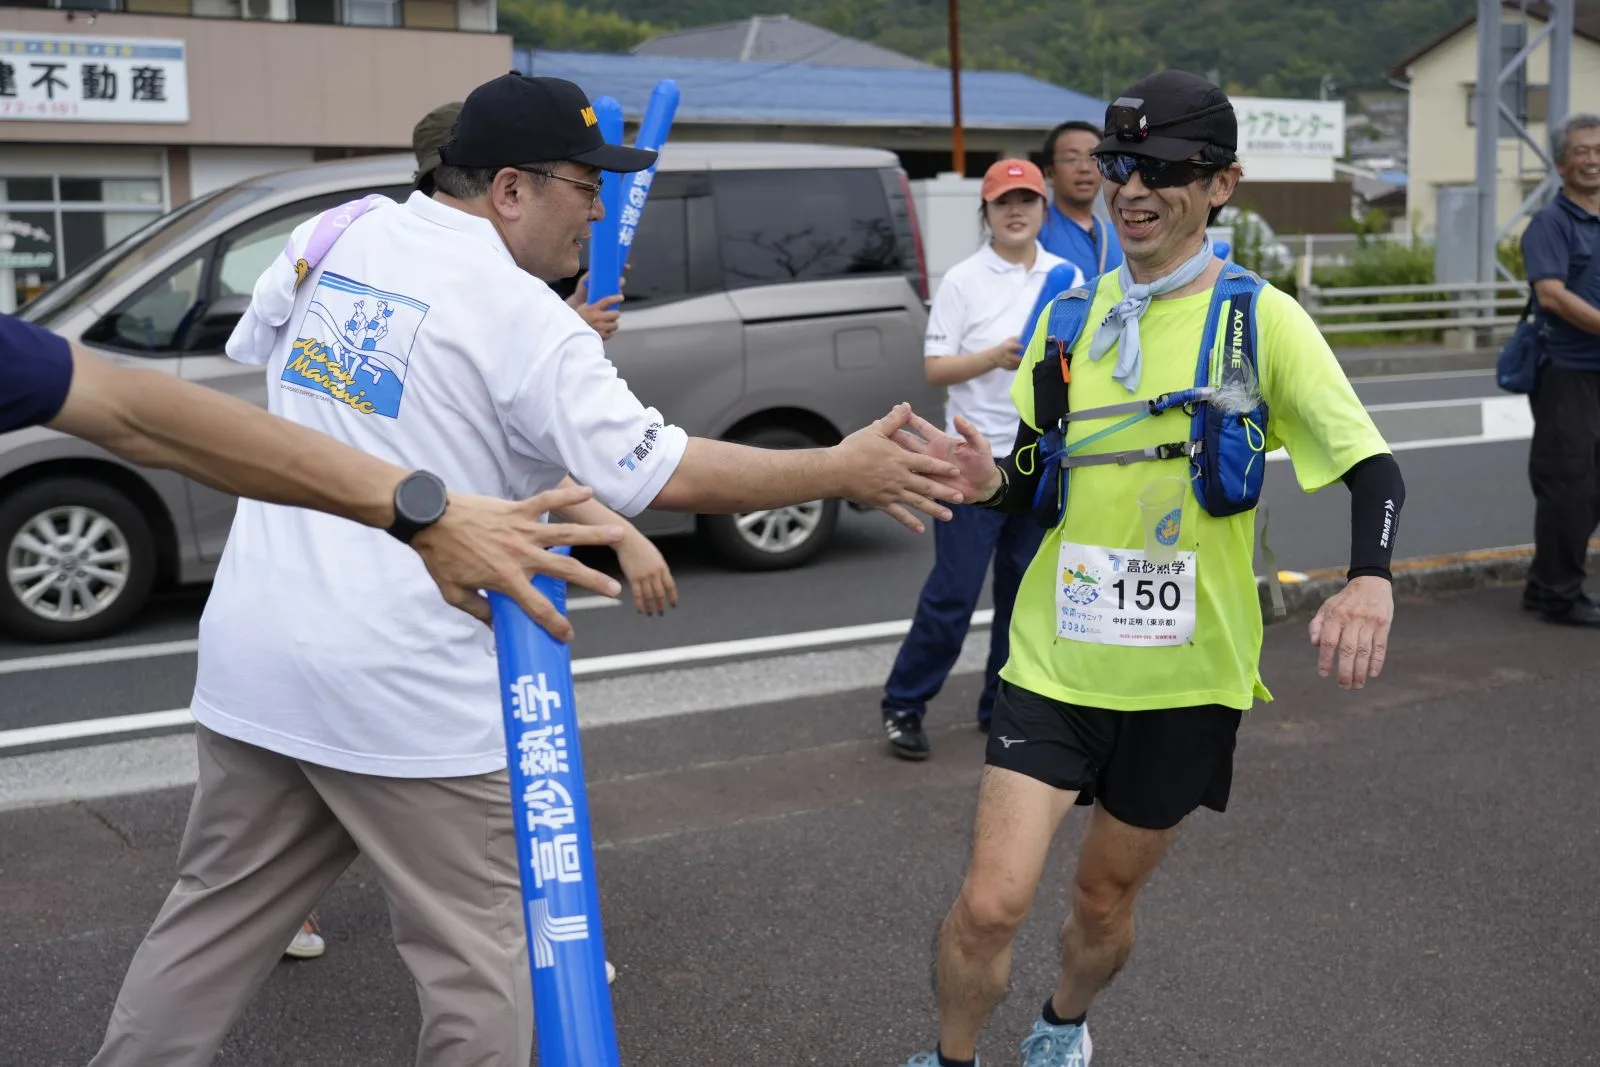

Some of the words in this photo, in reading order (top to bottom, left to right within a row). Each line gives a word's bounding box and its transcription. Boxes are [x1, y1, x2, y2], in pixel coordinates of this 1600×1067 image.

[1231, 309, 1244, 368] AONIJIE
[1112, 579, 1181, 611] 150
[510, 672, 582, 889] 高砂熱学
